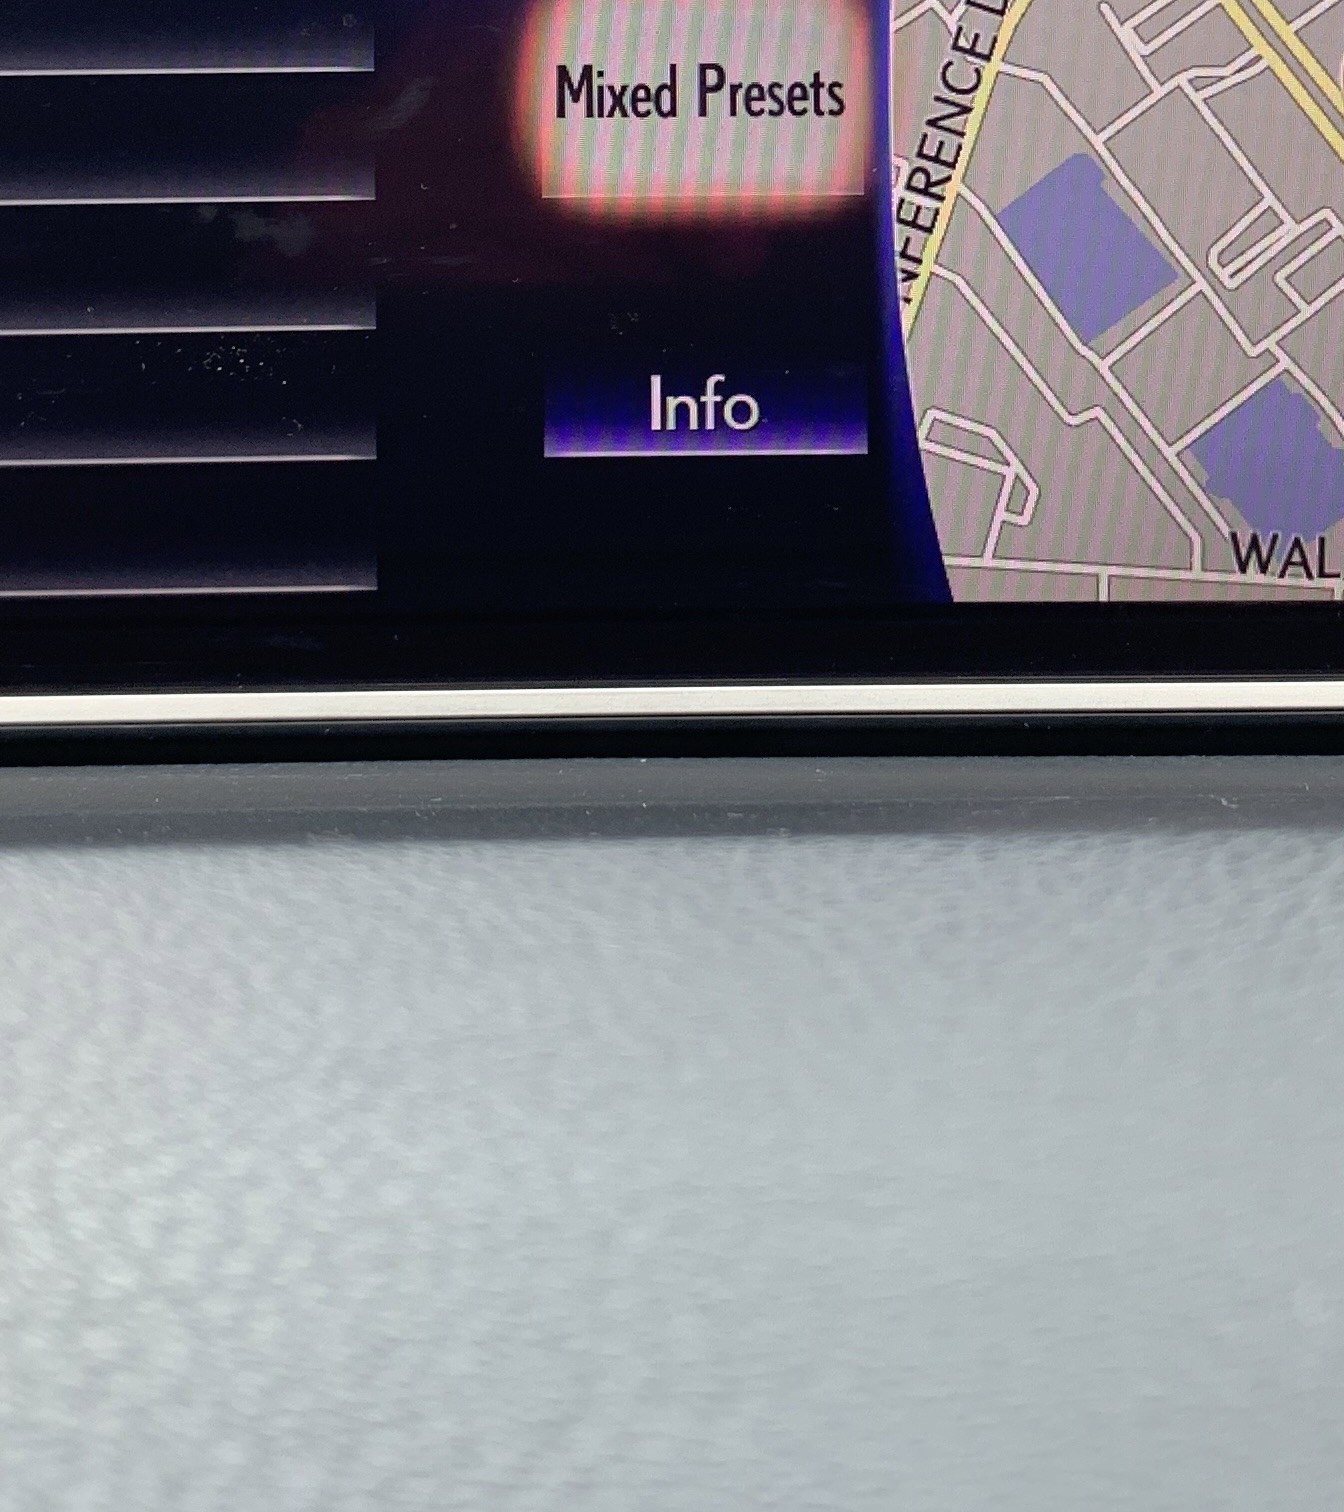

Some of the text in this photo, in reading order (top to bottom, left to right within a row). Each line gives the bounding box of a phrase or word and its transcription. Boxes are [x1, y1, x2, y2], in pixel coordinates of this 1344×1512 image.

[556, 63, 846, 120] Mixed Presets
[649, 373, 761, 432] Info
